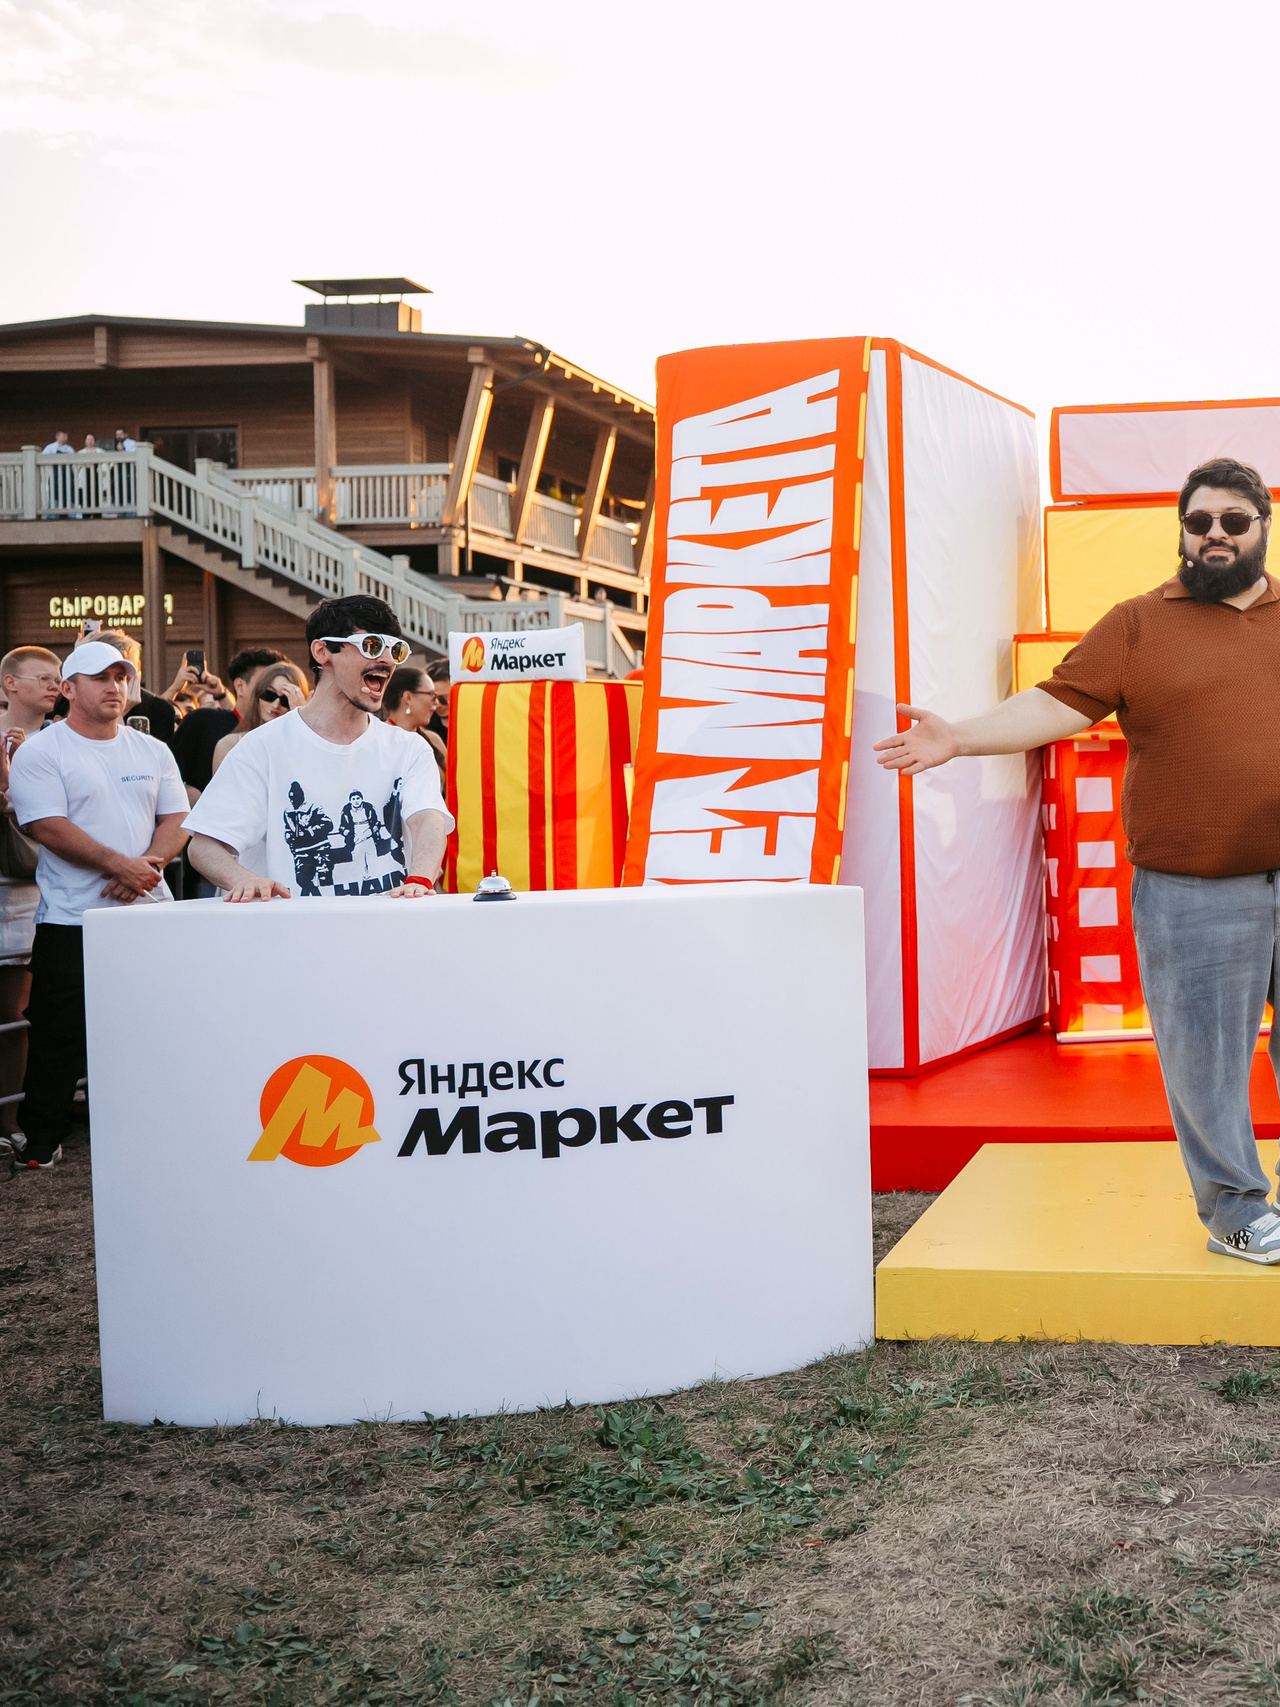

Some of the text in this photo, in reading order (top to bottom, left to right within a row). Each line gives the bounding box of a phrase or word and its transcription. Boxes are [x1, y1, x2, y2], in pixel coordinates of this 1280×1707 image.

[49, 594, 174, 617] СЫРОВАРЯ
[49, 618, 93, 628] РЕСТОР
[642, 369, 840, 886] ЕТ МАРКЕТА
[490, 638, 526, 651] Яндекс
[490, 652, 566, 672] Маркет
[398, 1058, 565, 1098] Яндекс
[396, 1095, 735, 1160] Маркет
